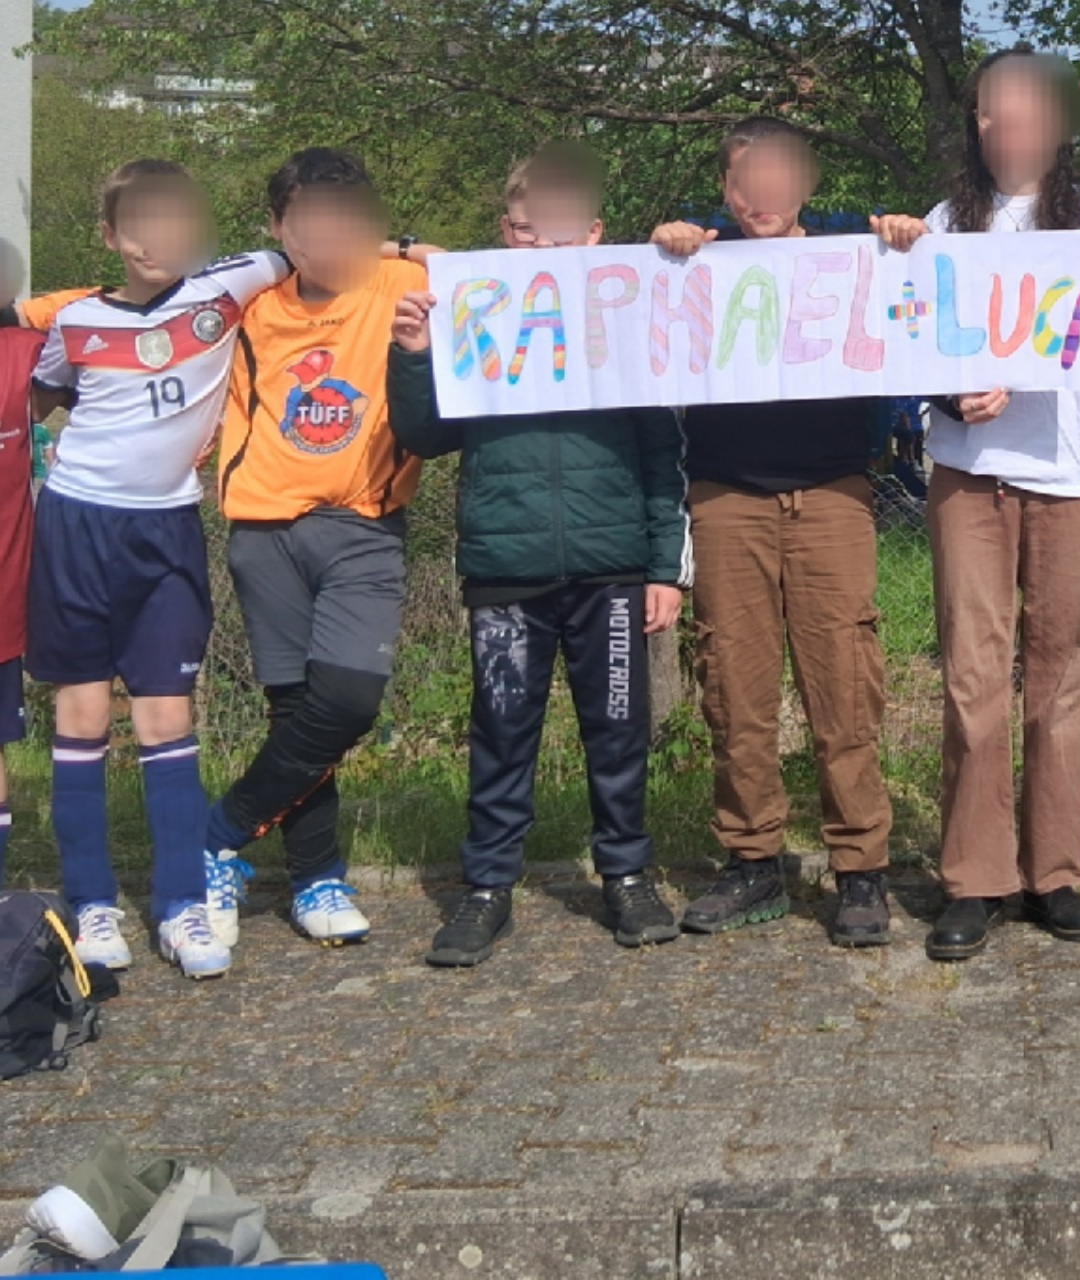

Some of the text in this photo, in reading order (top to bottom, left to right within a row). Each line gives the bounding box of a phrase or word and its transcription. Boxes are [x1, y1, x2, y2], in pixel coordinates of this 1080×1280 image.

[143, 376, 186, 418] 19
[297, 402, 351, 426] TÜFF
[607, 597, 630, 721] MOTOCROSS
